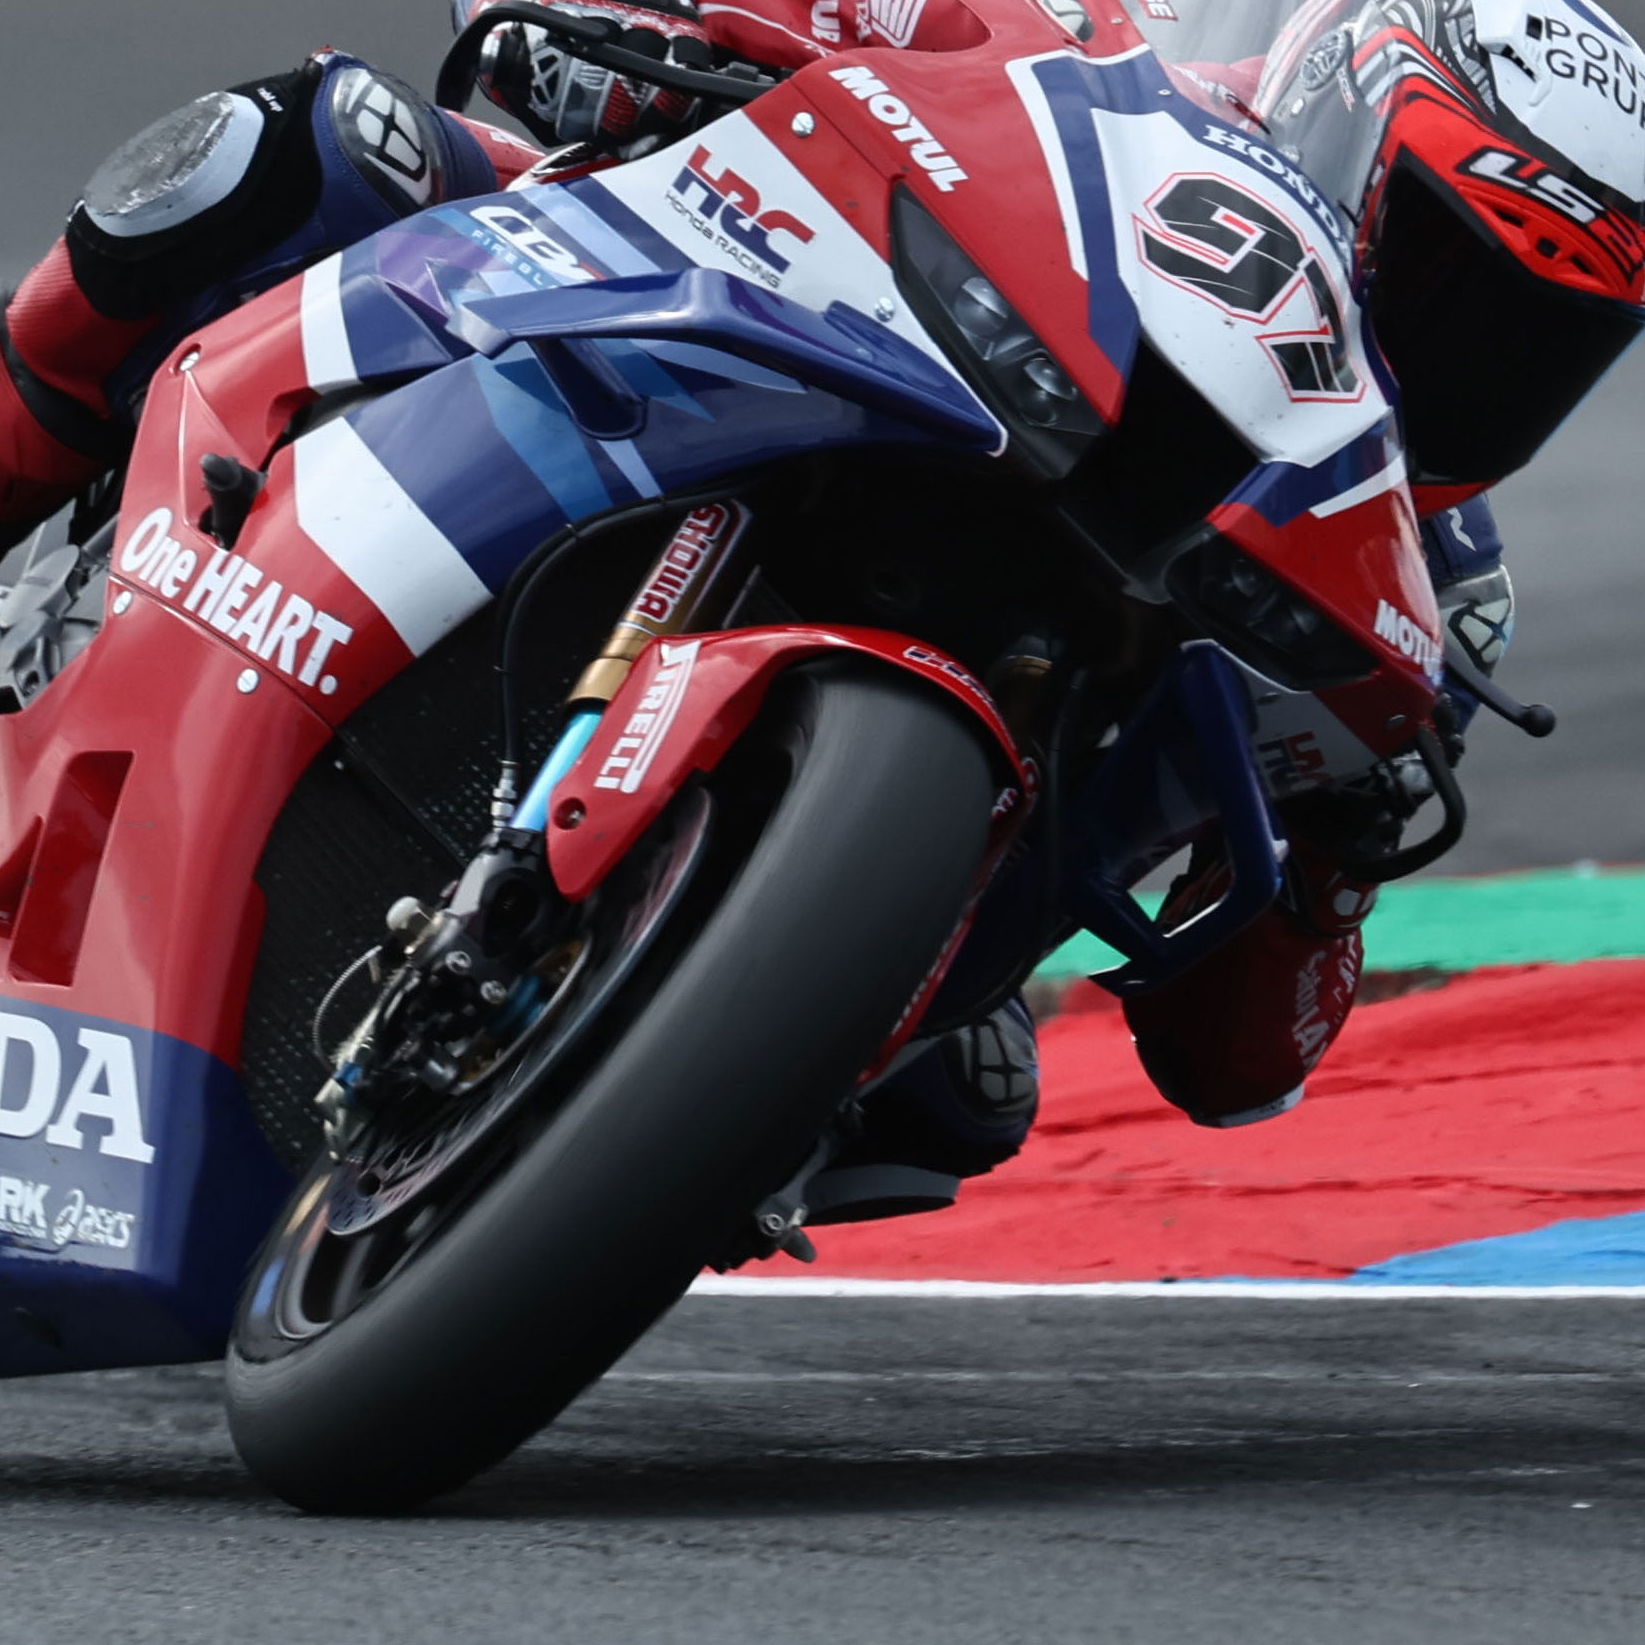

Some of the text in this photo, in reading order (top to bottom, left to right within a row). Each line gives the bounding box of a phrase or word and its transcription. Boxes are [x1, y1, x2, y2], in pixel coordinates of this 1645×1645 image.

[827, 66, 969, 192] MOTUL
[665, 190, 782, 289] Honda RACING
[672, 144, 817, 275] HRC
[120, 507, 354, 695] One HEART.
[635, 505, 729, 623] SHOWA
[593, 639, 702, 794] PIRELLI
